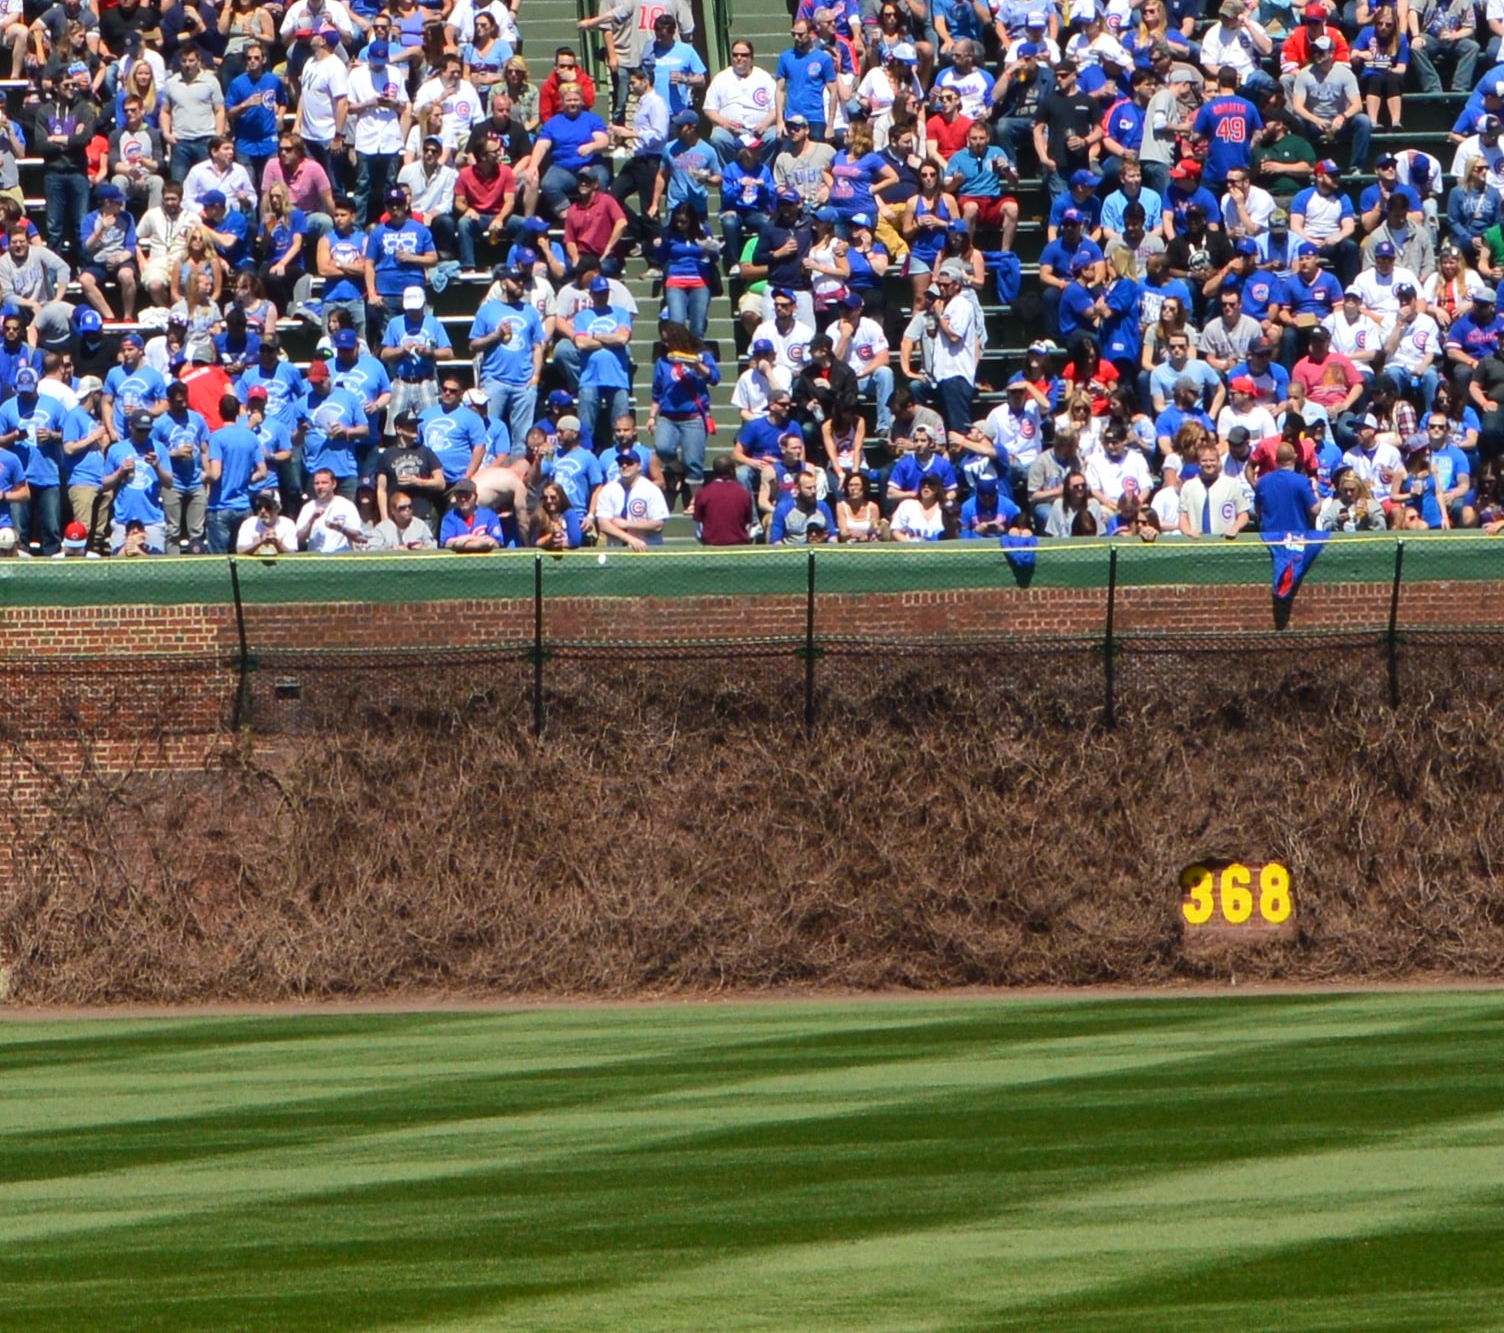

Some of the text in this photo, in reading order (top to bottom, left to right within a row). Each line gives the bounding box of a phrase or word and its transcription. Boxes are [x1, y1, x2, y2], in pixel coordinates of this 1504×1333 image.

[302, 70, 317, 90] W
[1217, 116, 1246, 142] 49
[1181, 862, 1292, 927] 368
